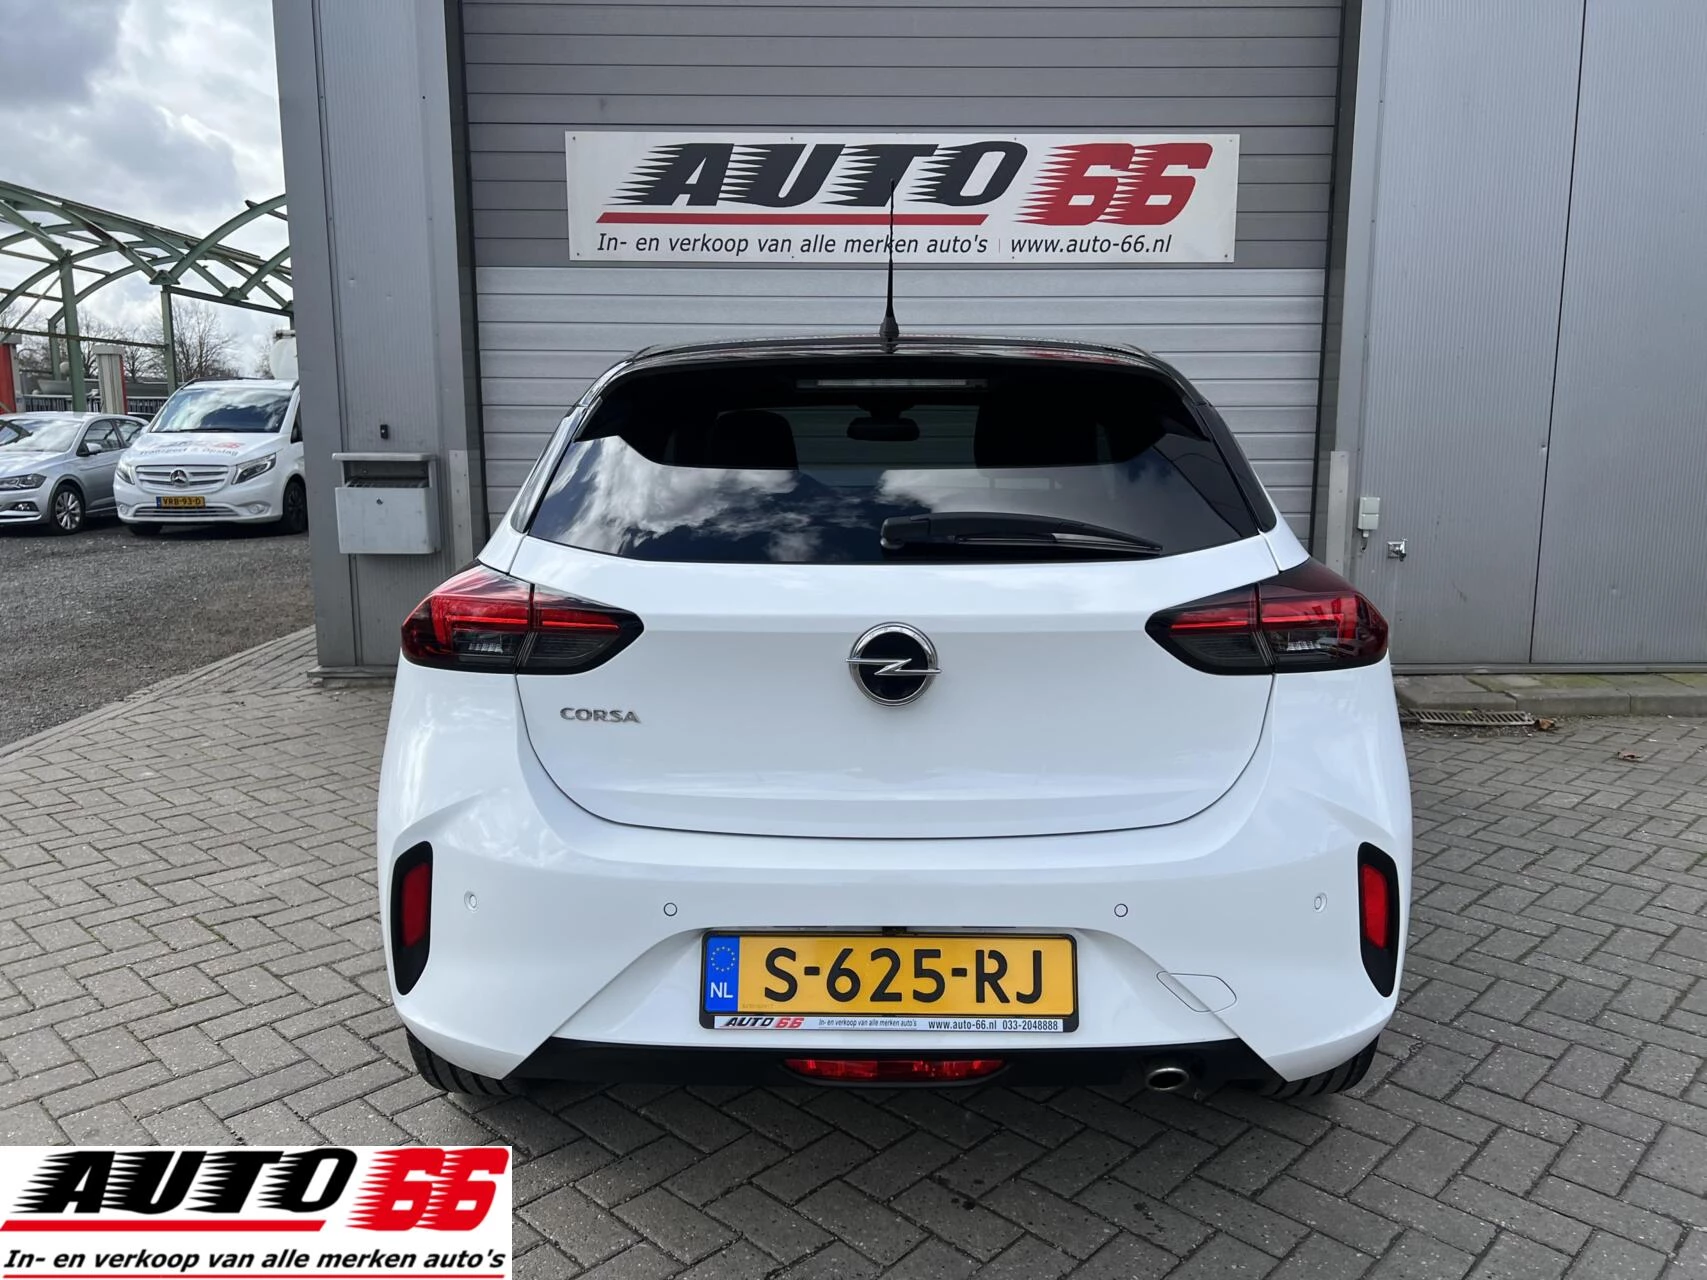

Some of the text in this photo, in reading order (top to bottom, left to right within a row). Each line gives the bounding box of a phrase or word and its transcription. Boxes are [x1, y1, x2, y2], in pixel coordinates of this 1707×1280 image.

[603, 142, 1213, 226] AUTO 66
[597, 233, 1172, 256] In- en verkoop van alle merken auto's www.auto-66.nl
[560, 707, 641, 724] CORSA
[764, 947, 1042, 1003] S-625-RJ
[710, 982, 733, 999] NL
[724, 1017, 804, 1029] AUTO 66
[836, 1018, 857, 1029] verkoop
[858, 1019, 869, 1027] van
[869, 1018, 880, 1027] alle
[880, 1019, 900, 1027] merken
[901, 1019, 918, 1027] auto's
[928, 1019, 997, 1031] www.auto-66.nl
[1002, 1020, 1058, 1031] 033-2048888
